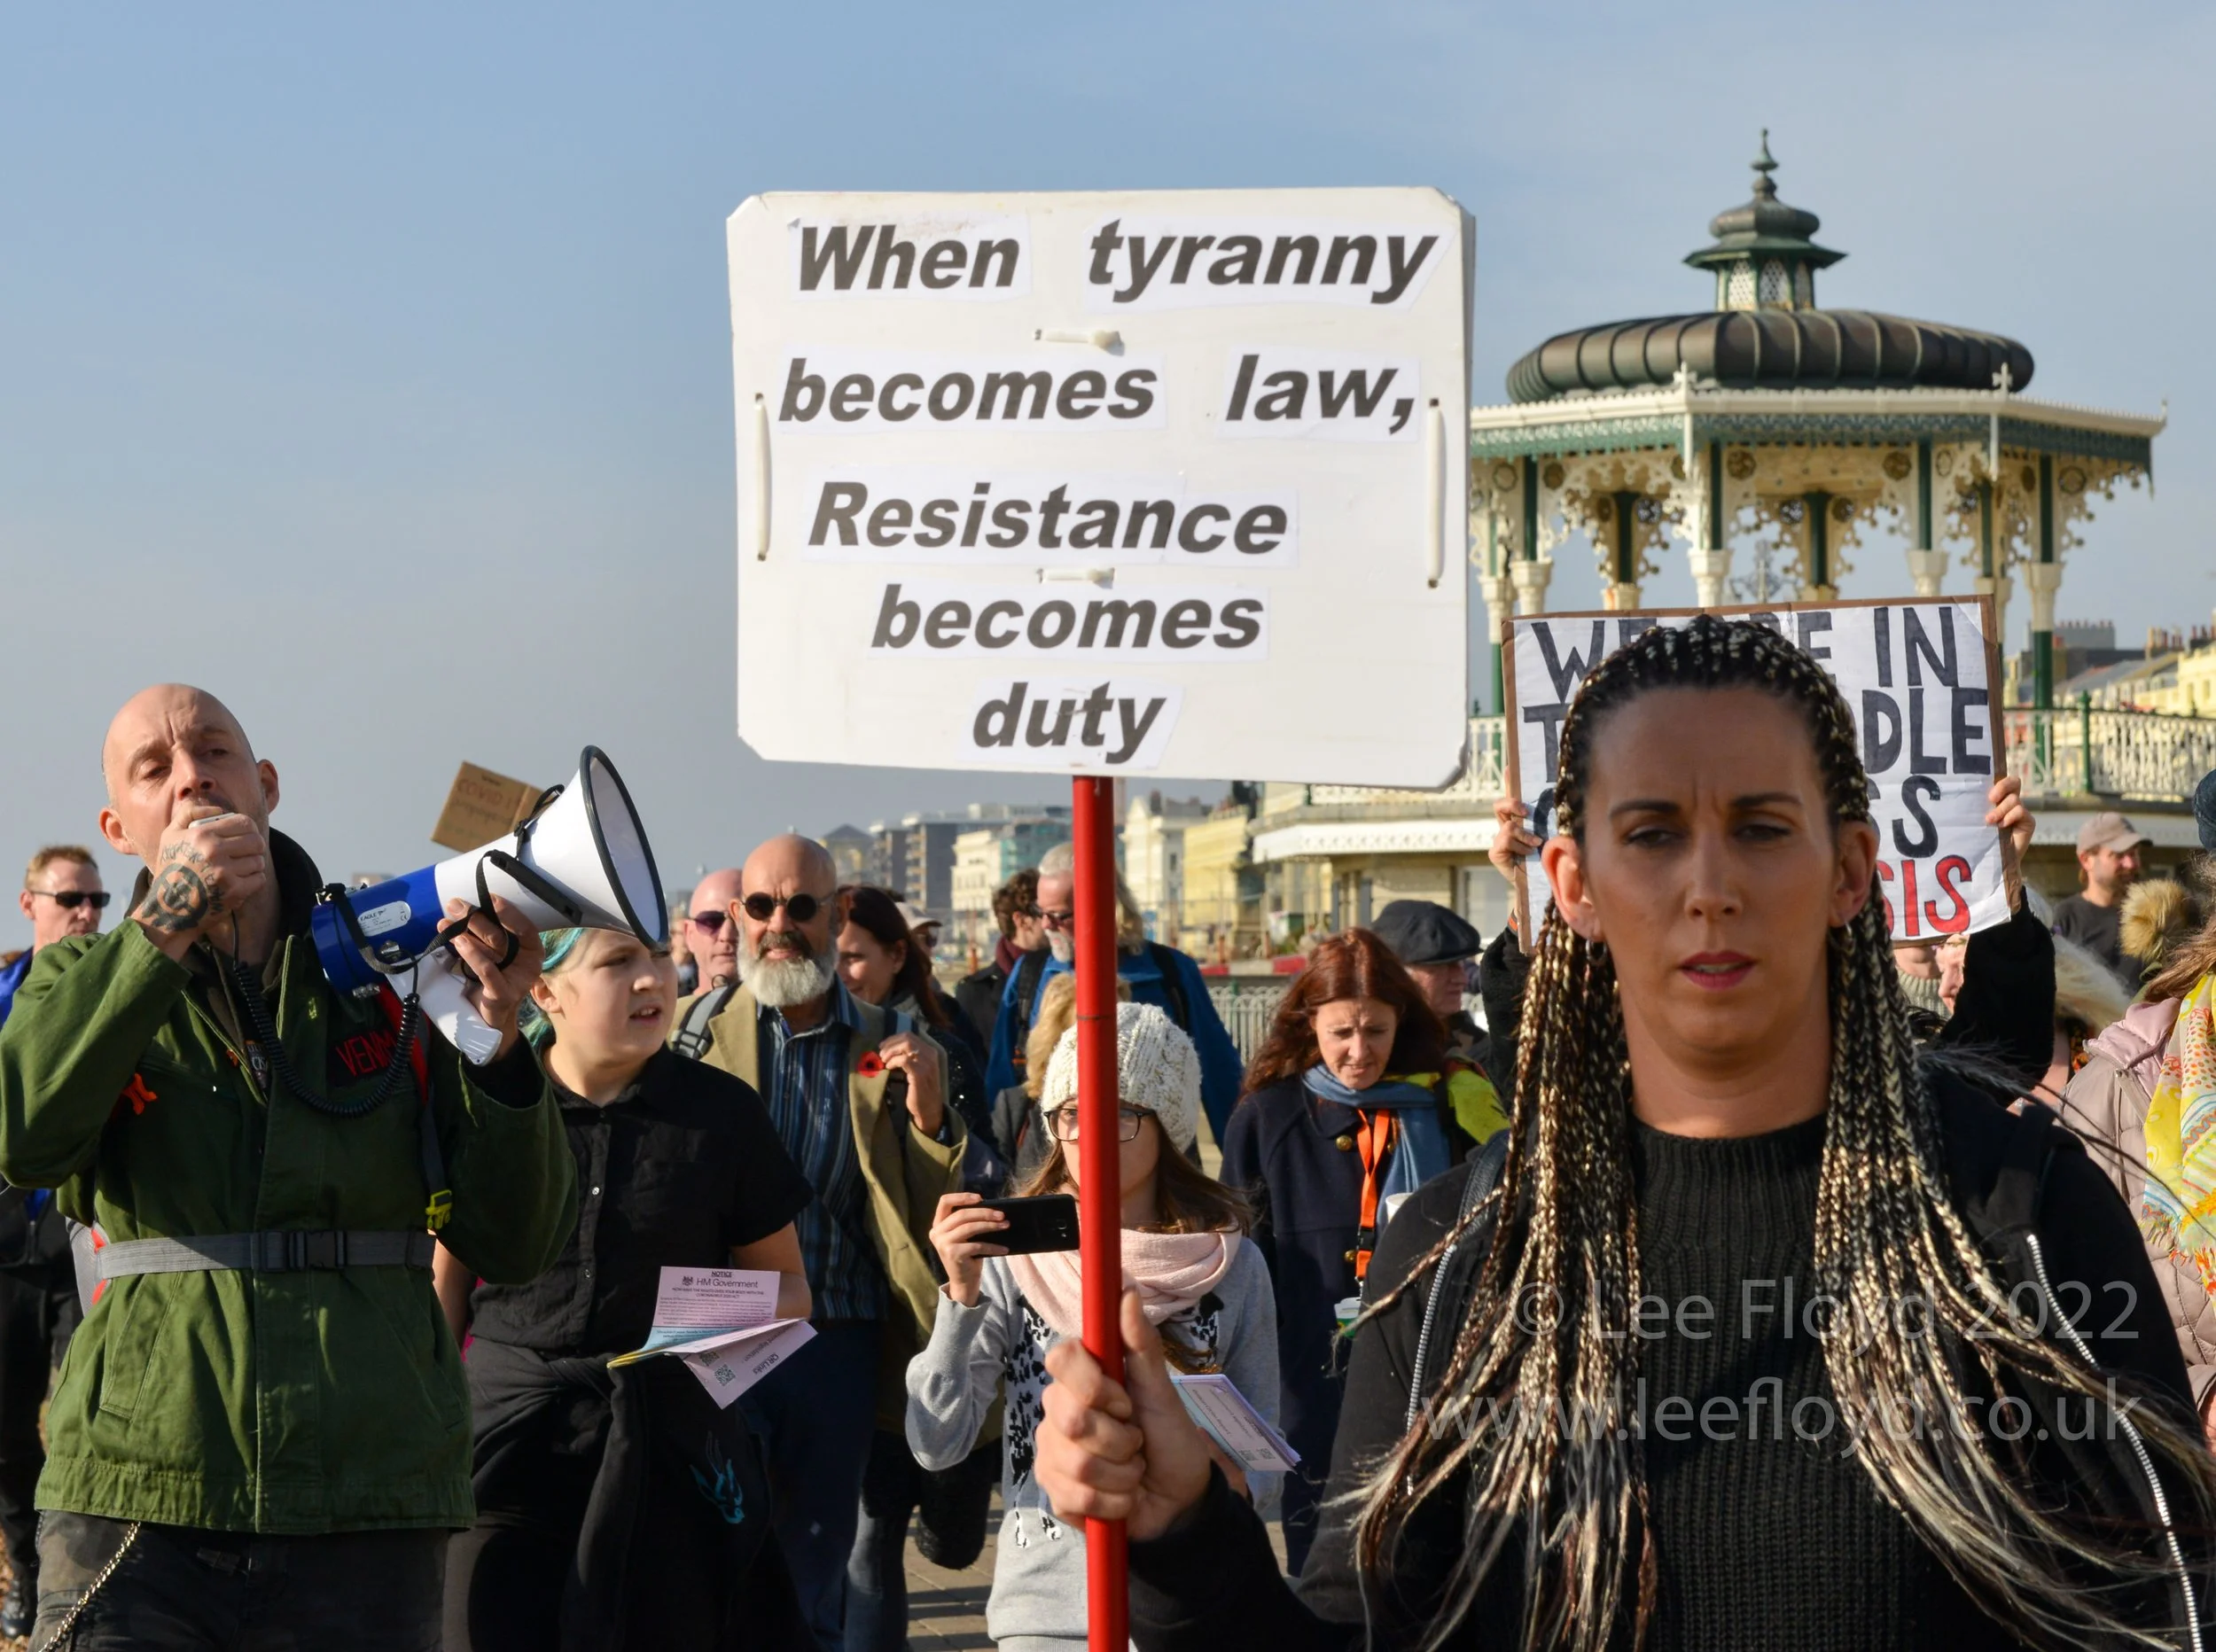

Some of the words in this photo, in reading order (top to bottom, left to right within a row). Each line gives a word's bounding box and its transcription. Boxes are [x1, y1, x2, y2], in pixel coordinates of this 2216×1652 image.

[798, 225, 1018, 290] When
[1088, 219, 1439, 304] tyranny
[780, 358, 1157, 422] becomes
[1225, 355, 1415, 434] law,
[809, 481, 1288, 554] Resistance
[871, 585, 1263, 650] becomes
[1873, 605, 1957, 688] IN
[972, 682, 1166, 764] duty
[1862, 687, 1992, 775] DLE
[713, 1278, 759, 1289] Government
